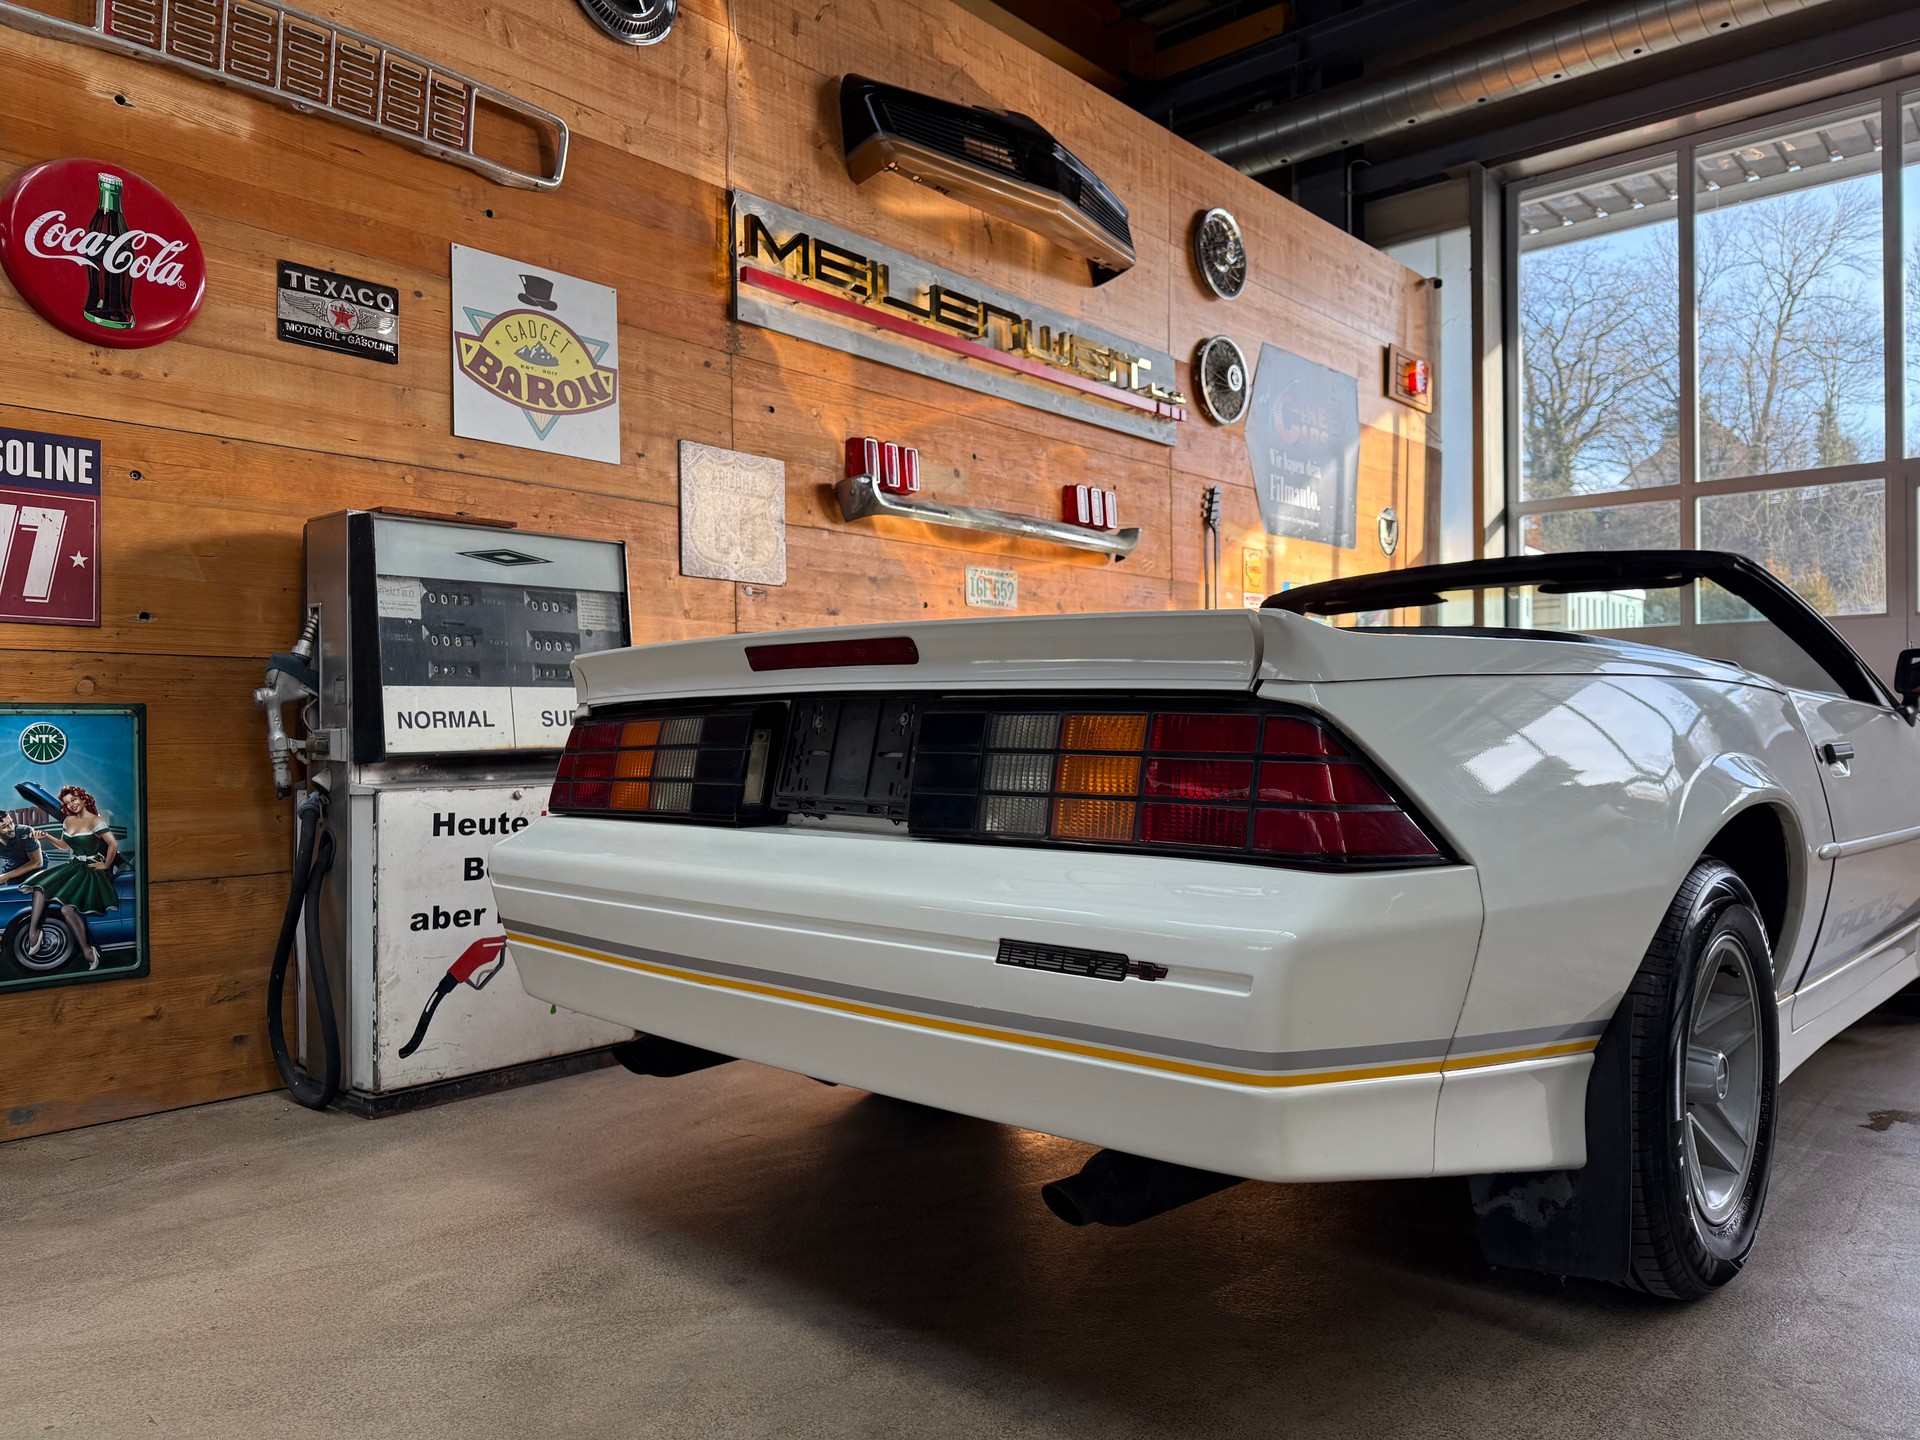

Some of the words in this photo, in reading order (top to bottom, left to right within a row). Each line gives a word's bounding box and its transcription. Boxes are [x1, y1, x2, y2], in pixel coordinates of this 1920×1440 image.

[24, 209, 189, 287] Coca-Cola
[284, 269, 394, 313] TEXACO
[285, 322, 323, 338] MOTOR
[324, 328, 340, 341] OIL
[347, 335, 395, 354] GASOLINE
[505, 319, 573, 354] GADGET
[465, 344, 612, 409] BARON
[542, 369, 559, 377] 2017
[0, 438, 93, 484] OLINE
[1269, 473, 1322, 512] Filmauto.
[397, 710, 496, 729] NORMAL
[29, 734, 58, 744] NTK
[432, 812, 529, 837] Heute
[463, 857, 490, 881] B
[409, 905, 487, 932] aber
